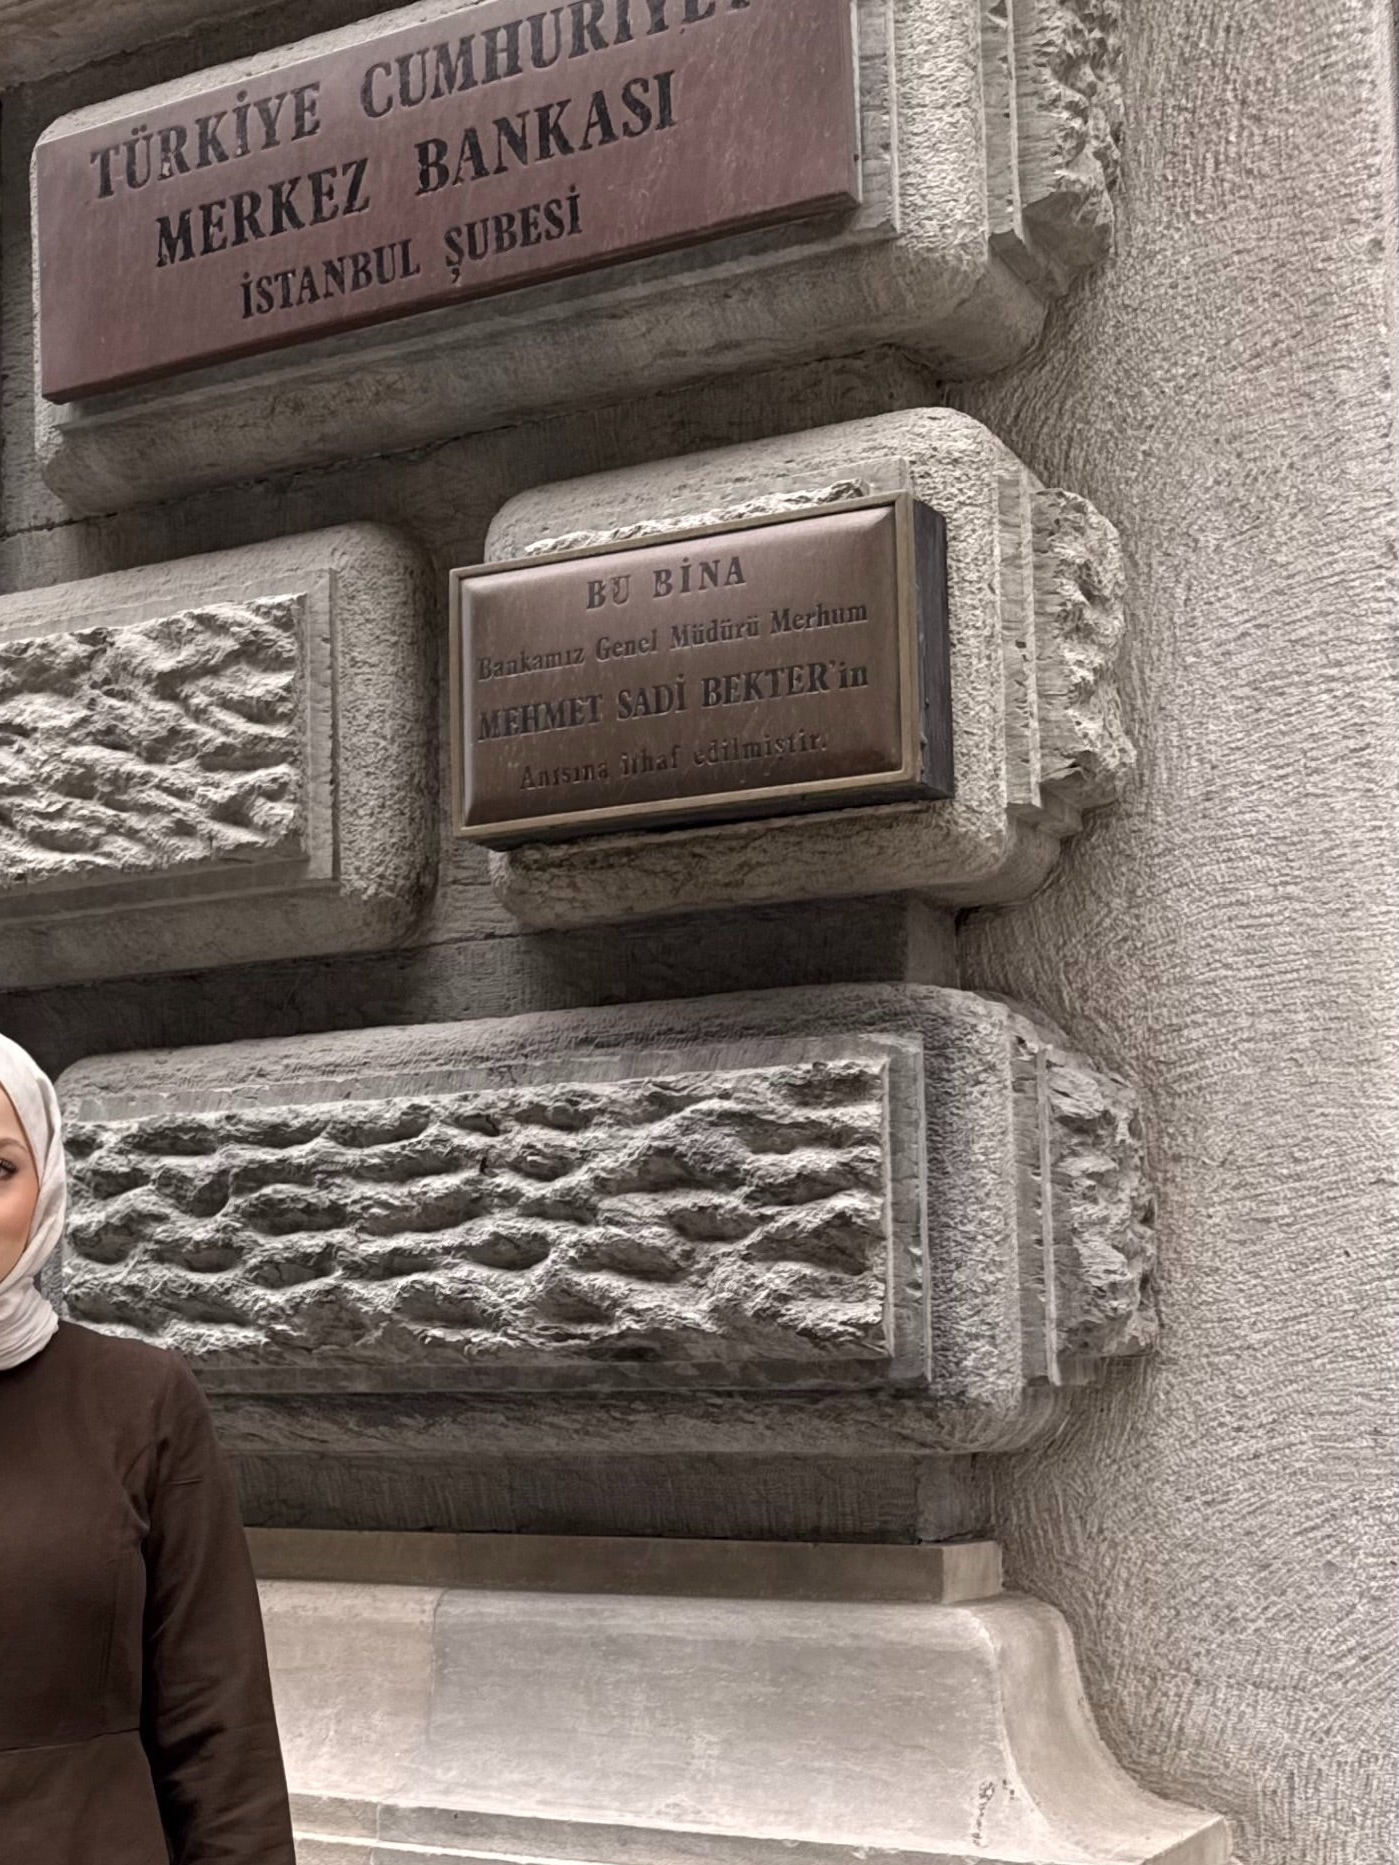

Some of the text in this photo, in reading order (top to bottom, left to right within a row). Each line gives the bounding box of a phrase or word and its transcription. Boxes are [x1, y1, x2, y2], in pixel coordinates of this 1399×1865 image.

[90, 80, 322, 201] TÜRKİYE
[155, 69, 679, 268] MERKEZ BANKASI
[241, 185, 584, 319] İSTANBUL ŞUBESİ
[586, 556, 747, 610] BU BİNA
[477, 602, 869, 681] Bankamız Genel Müdürü Merhum
[477, 692, 603, 742] MEHMET
[616, 673, 688, 721] SADİ
